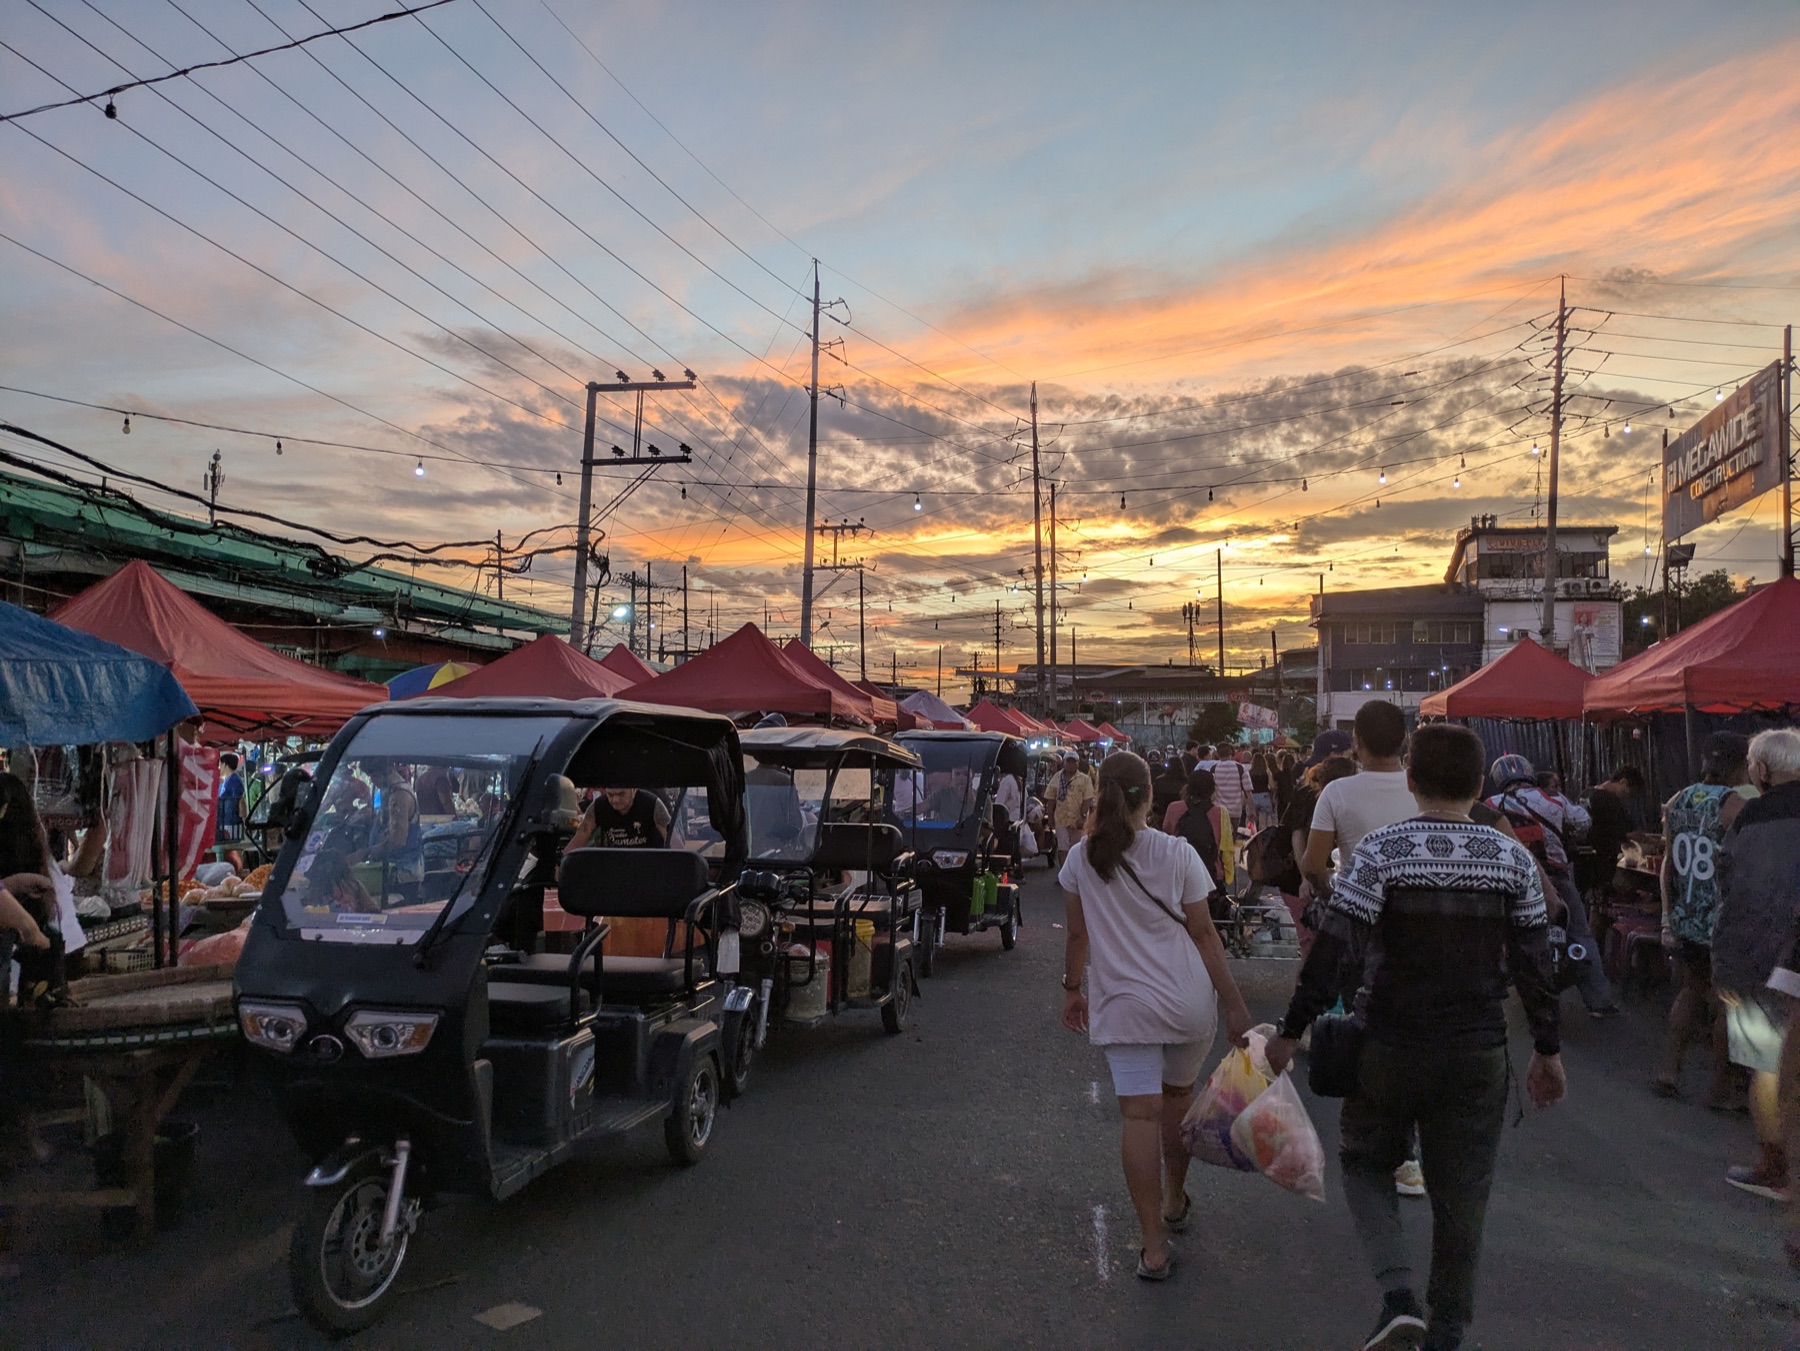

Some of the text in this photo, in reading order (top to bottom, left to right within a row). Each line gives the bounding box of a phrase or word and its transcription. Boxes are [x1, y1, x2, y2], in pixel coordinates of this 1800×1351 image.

[1678, 403, 1757, 487] MEGAWIDE
[1689, 442, 1758, 501] CONSTRUCTION
[1672, 832, 1715, 881] 08
